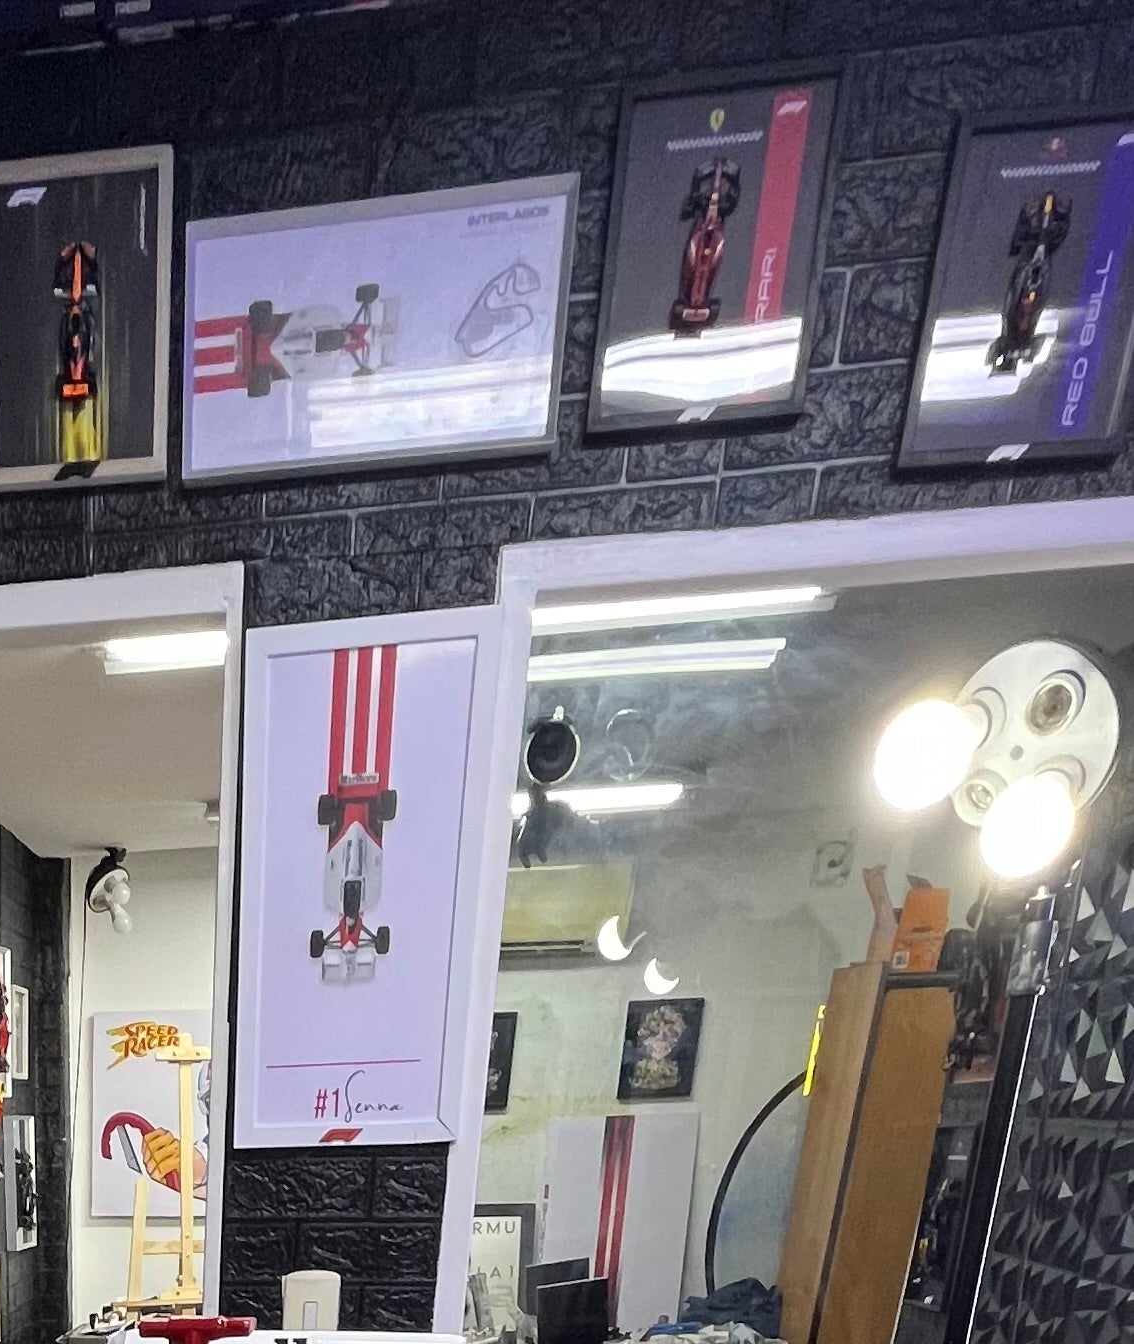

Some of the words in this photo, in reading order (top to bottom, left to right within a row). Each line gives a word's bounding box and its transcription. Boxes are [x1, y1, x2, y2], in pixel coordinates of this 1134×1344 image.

[467, 205, 550, 227] INTERLAGOS
[1061, 356, 1088, 427] RED
[1078, 250, 1114, 348] BULL
[124, 1024, 179, 1038] SPEED
[123, 1036, 181, 1058] RACER
